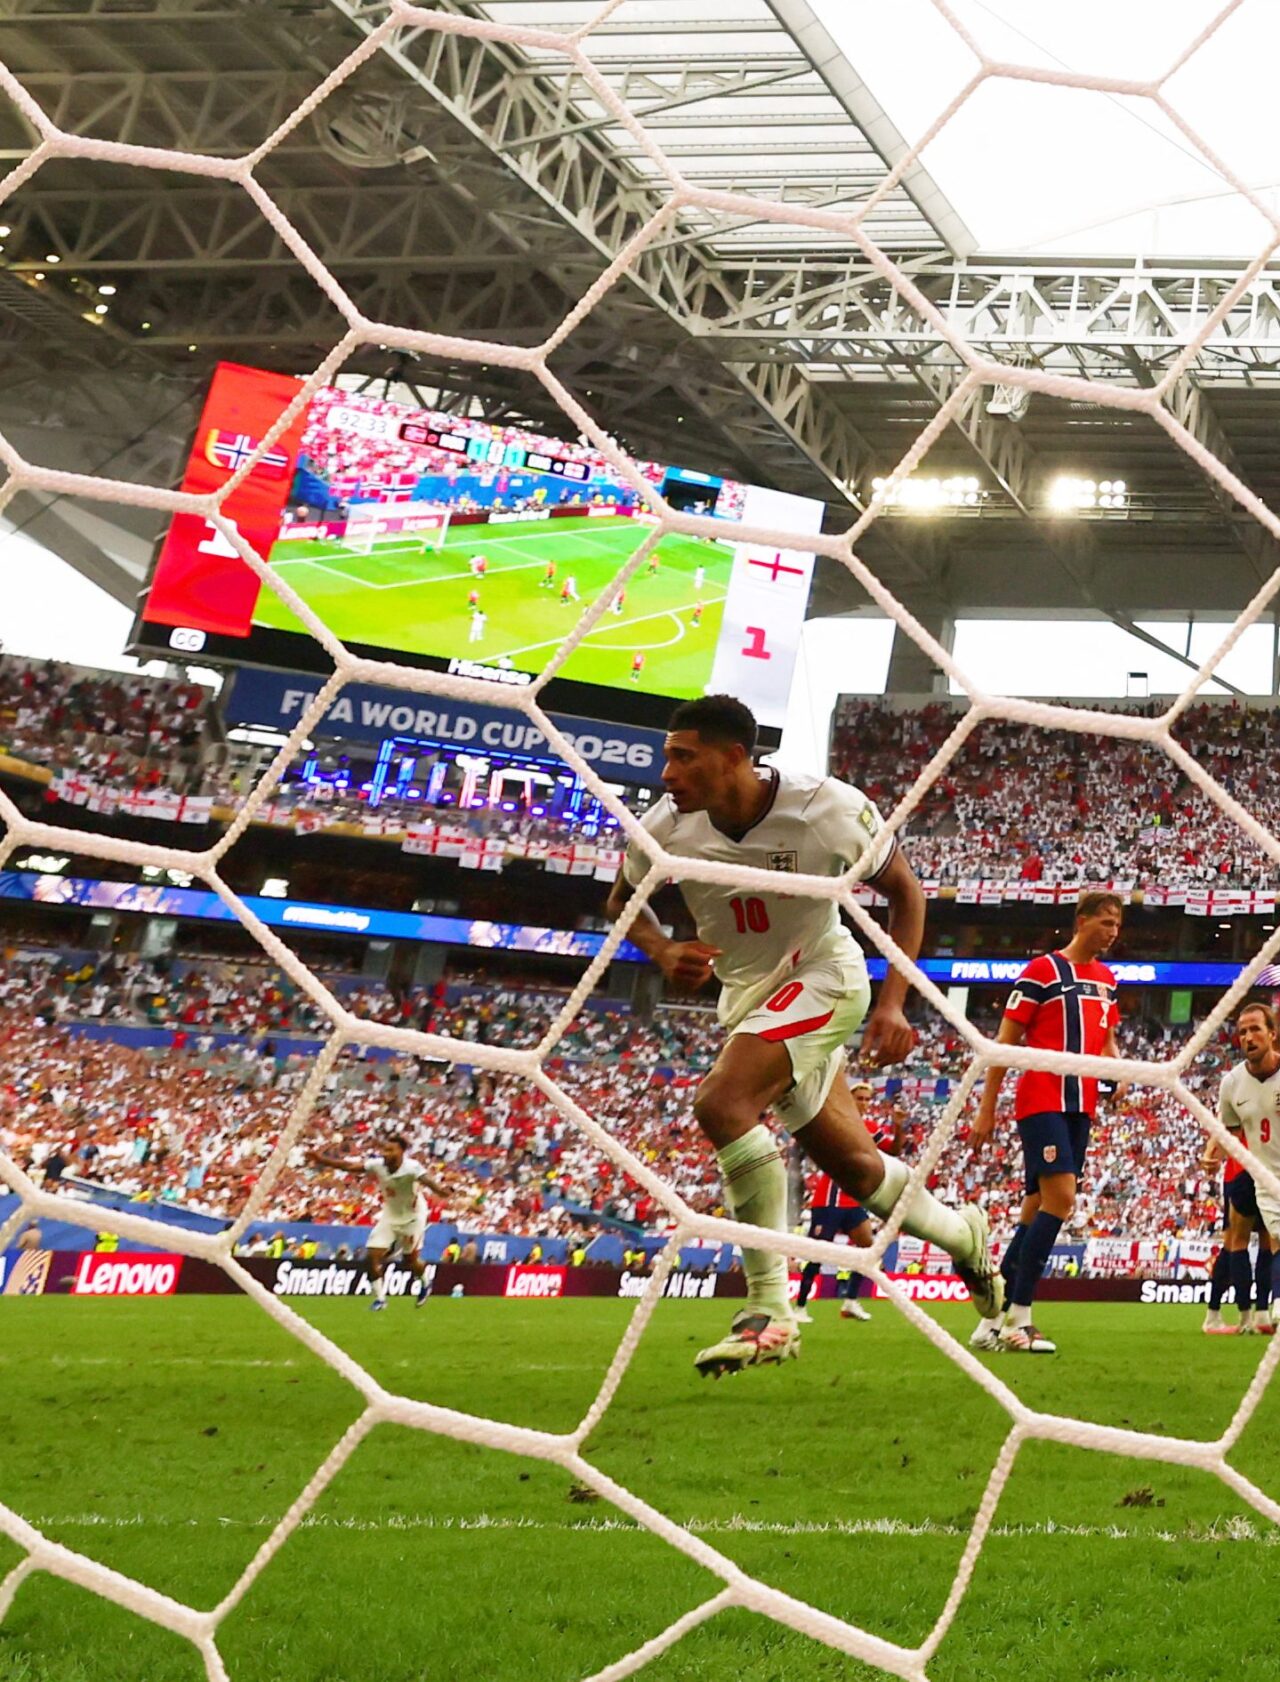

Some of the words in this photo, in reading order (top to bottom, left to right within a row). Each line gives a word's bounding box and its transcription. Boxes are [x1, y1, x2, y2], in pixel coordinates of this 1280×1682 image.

[741, 626, 771, 660] 1
[280, 689, 354, 723] FIA
[361, 700, 478, 741] WORLD
[481, 721, 546, 751] CUP
[730, 897, 769, 934] 10
[951, 963, 989, 979] FIFA
[1260, 1118, 1271, 1143] 9
[74, 1254, 176, 1294] Lenovo
[273, 1262, 357, 1294] Smarter
[381, 1263, 412, 1294] for
[682, 1272, 702, 1298] for
